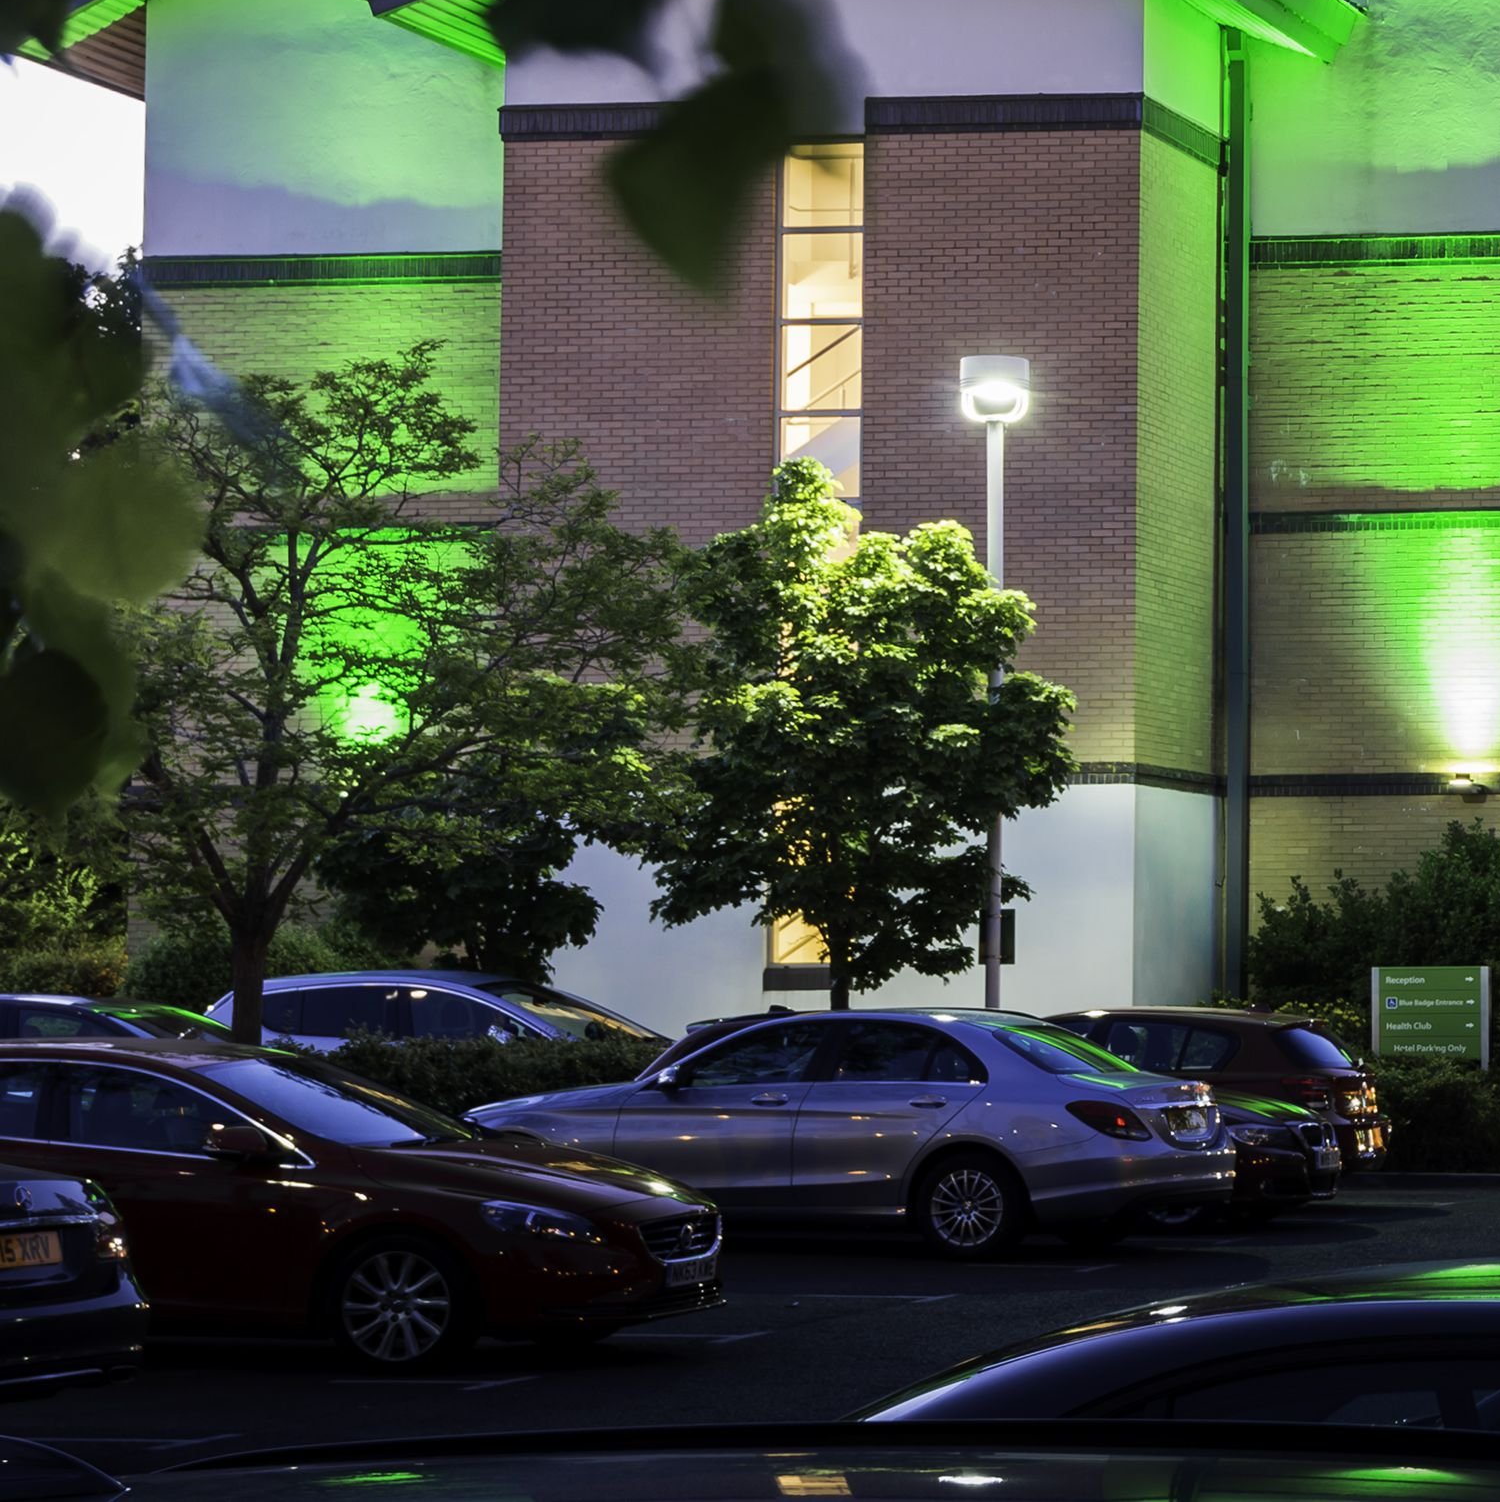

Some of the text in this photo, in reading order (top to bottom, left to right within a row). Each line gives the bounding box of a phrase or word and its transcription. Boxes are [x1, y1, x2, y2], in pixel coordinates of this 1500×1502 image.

[1385, 976, 1425, 985] Reception
[1414, 999, 1434, 1007] Badge
[1386, 1022, 1432, 1030] Health Club
[1394, 1044, 1466, 1053] Hotel Parking Only
